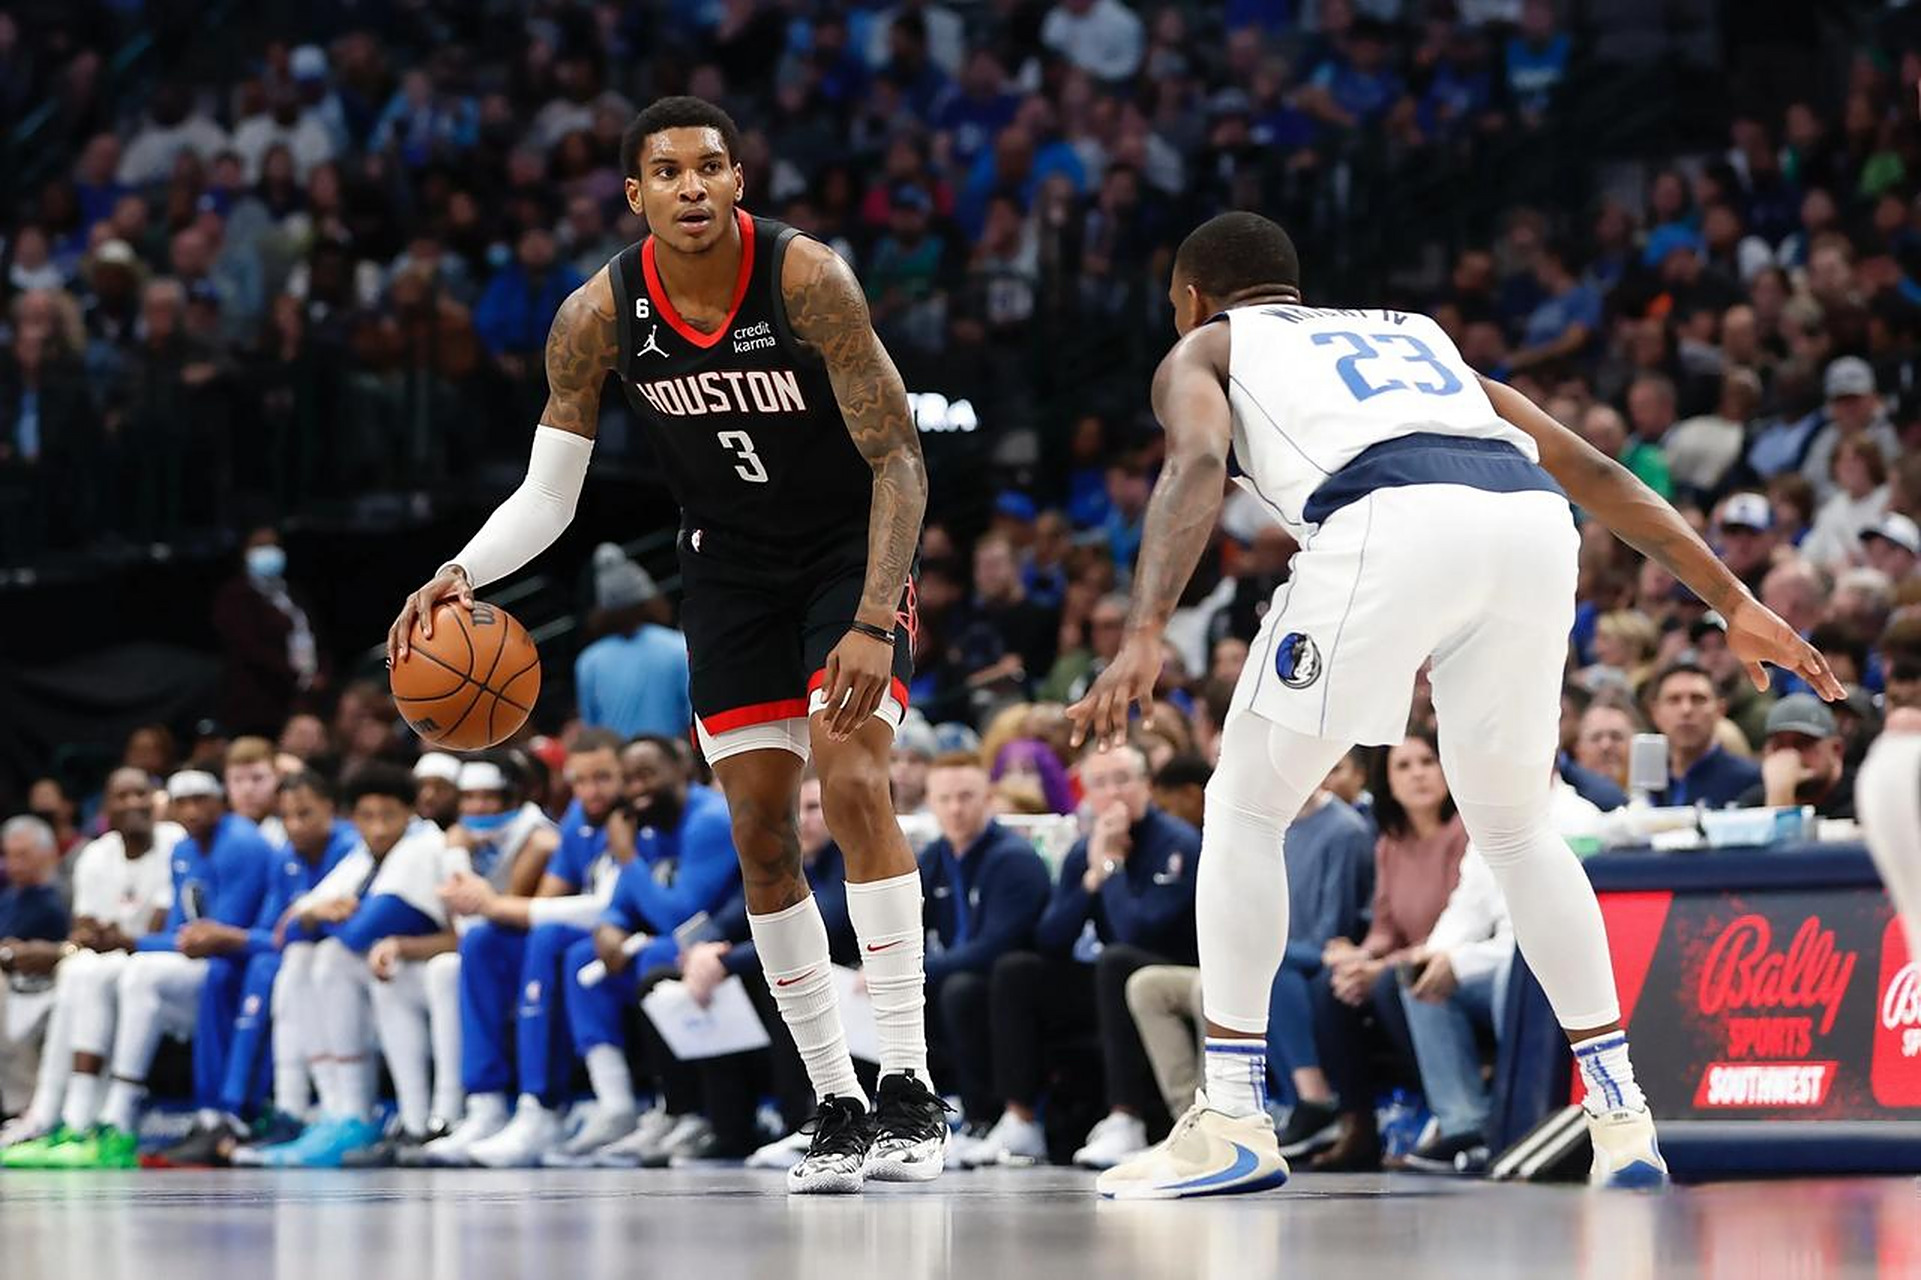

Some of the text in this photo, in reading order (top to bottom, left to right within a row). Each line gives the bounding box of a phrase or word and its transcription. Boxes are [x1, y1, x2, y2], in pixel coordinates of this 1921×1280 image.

[636, 298, 649, 318] 6
[733, 335, 776, 353] karma
[734, 321, 771, 340] credit
[1310, 331, 1463, 402] 23
[637, 371, 806, 416] HOUSTON
[717, 430, 769, 483] 3
[1700, 914, 1858, 1036] Bally
[1727, 1017, 1813, 1056] SPORTS
[1708, 1066, 1825, 1104] SOUTHWEST
